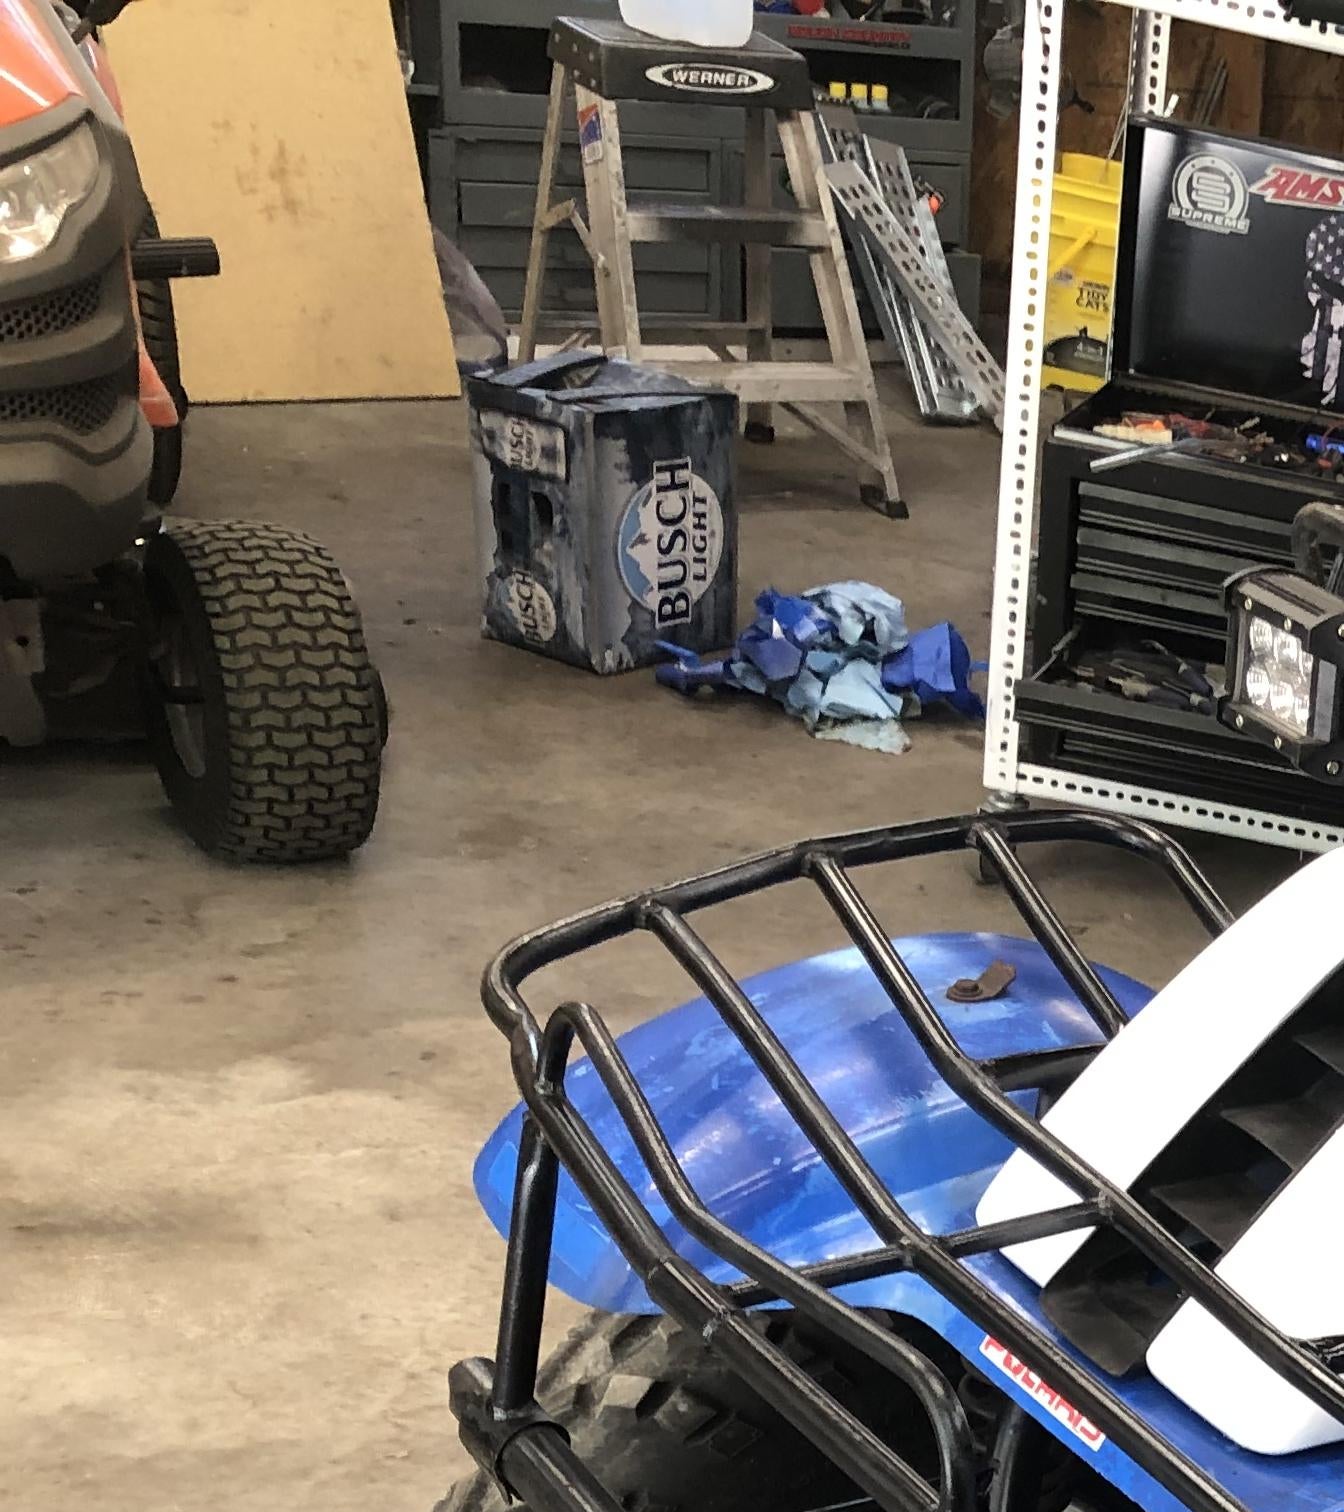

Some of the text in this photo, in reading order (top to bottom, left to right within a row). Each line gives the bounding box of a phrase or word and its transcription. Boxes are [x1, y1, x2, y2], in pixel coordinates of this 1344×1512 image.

[671, 69, 751, 88] WERNER
[1171, 206, 1247, 231] SUPREME
[1076, 297, 1110, 313] CATS
[655, 460, 691, 625] BUSCH
[693, 494, 708, 582] LIGHT
[514, 568, 545, 645] BUSCH
